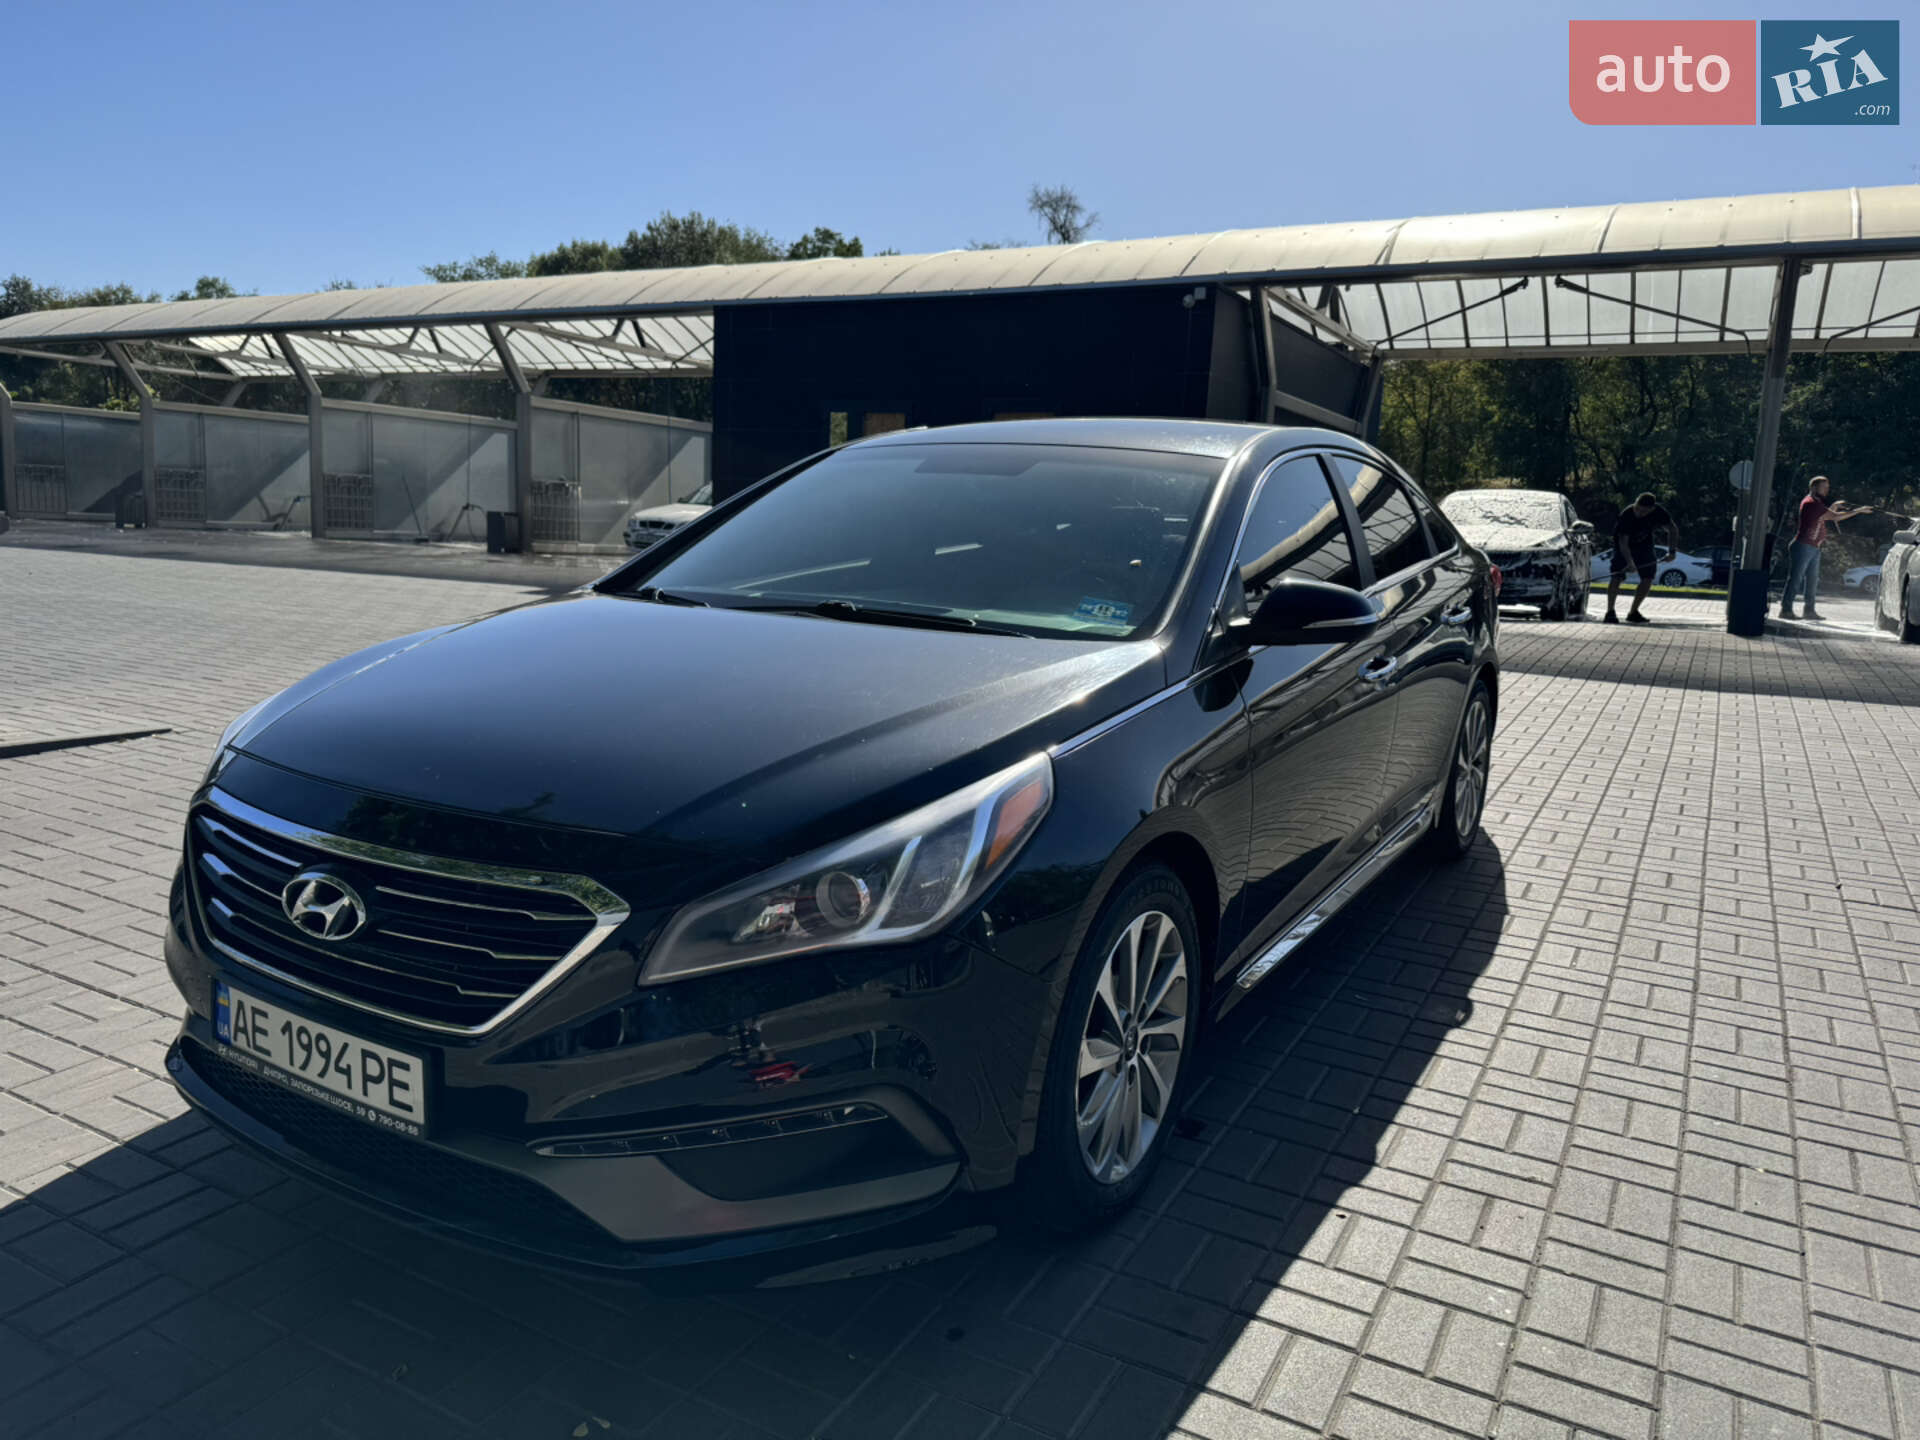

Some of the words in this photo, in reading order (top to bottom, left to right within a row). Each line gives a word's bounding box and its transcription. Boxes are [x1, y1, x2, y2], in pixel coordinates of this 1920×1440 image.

[219, 1023, 229, 1038] UA
[233, 1000, 272, 1057] AE
[281, 1020, 352, 1090] 1994
[361, 1048, 413, 1112] PE
